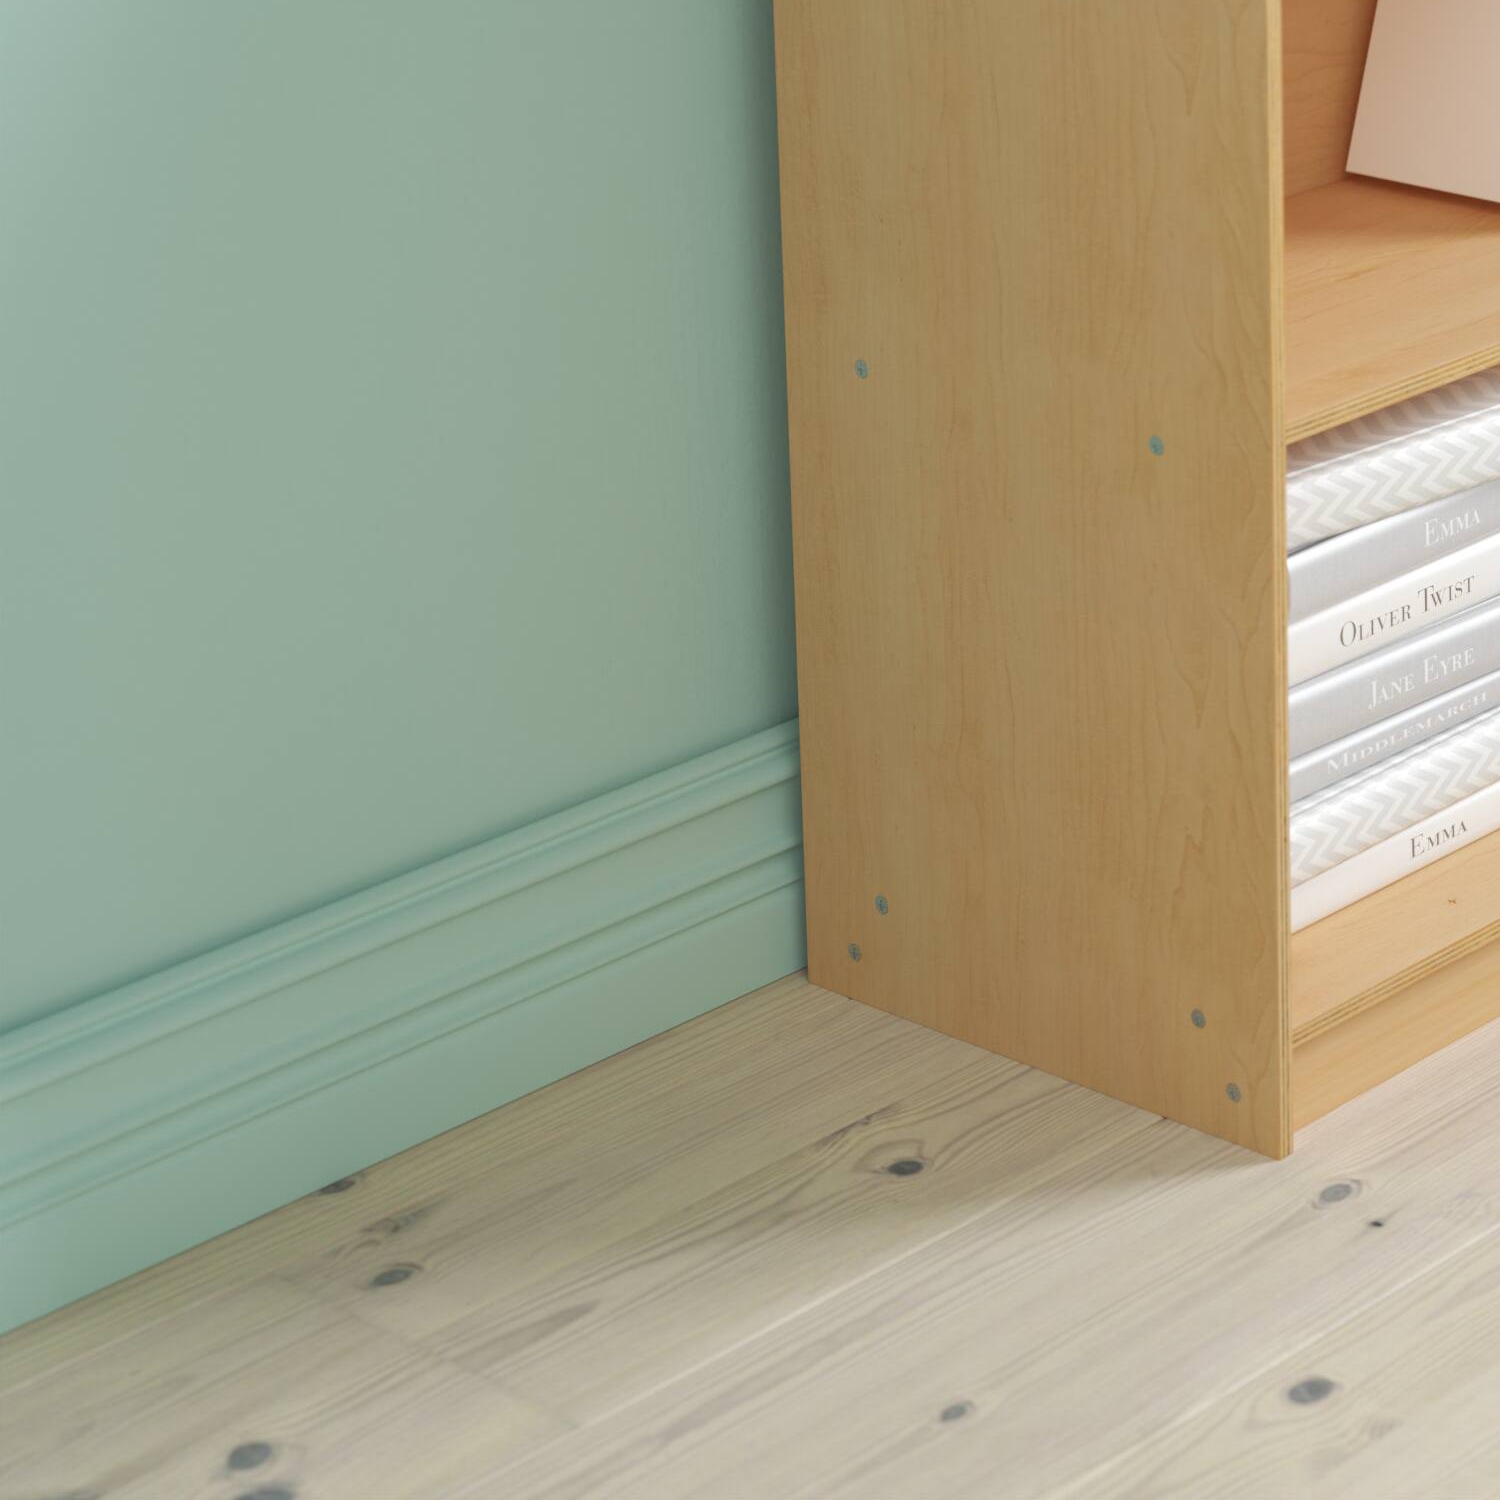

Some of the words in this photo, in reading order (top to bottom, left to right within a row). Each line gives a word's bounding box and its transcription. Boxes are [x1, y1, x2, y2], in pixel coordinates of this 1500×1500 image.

[1424, 509, 1481, 547] EMMA
[1339, 604, 1412, 648] OLIVER
[1417, 575, 1476, 613] TWIST
[1368, 673, 1416, 710] JANE
[1422, 647, 1476, 684] EYRE
[1326, 691, 1488, 775] MIDDLEMARCH
[1409, 819, 1468, 859] EMMA
